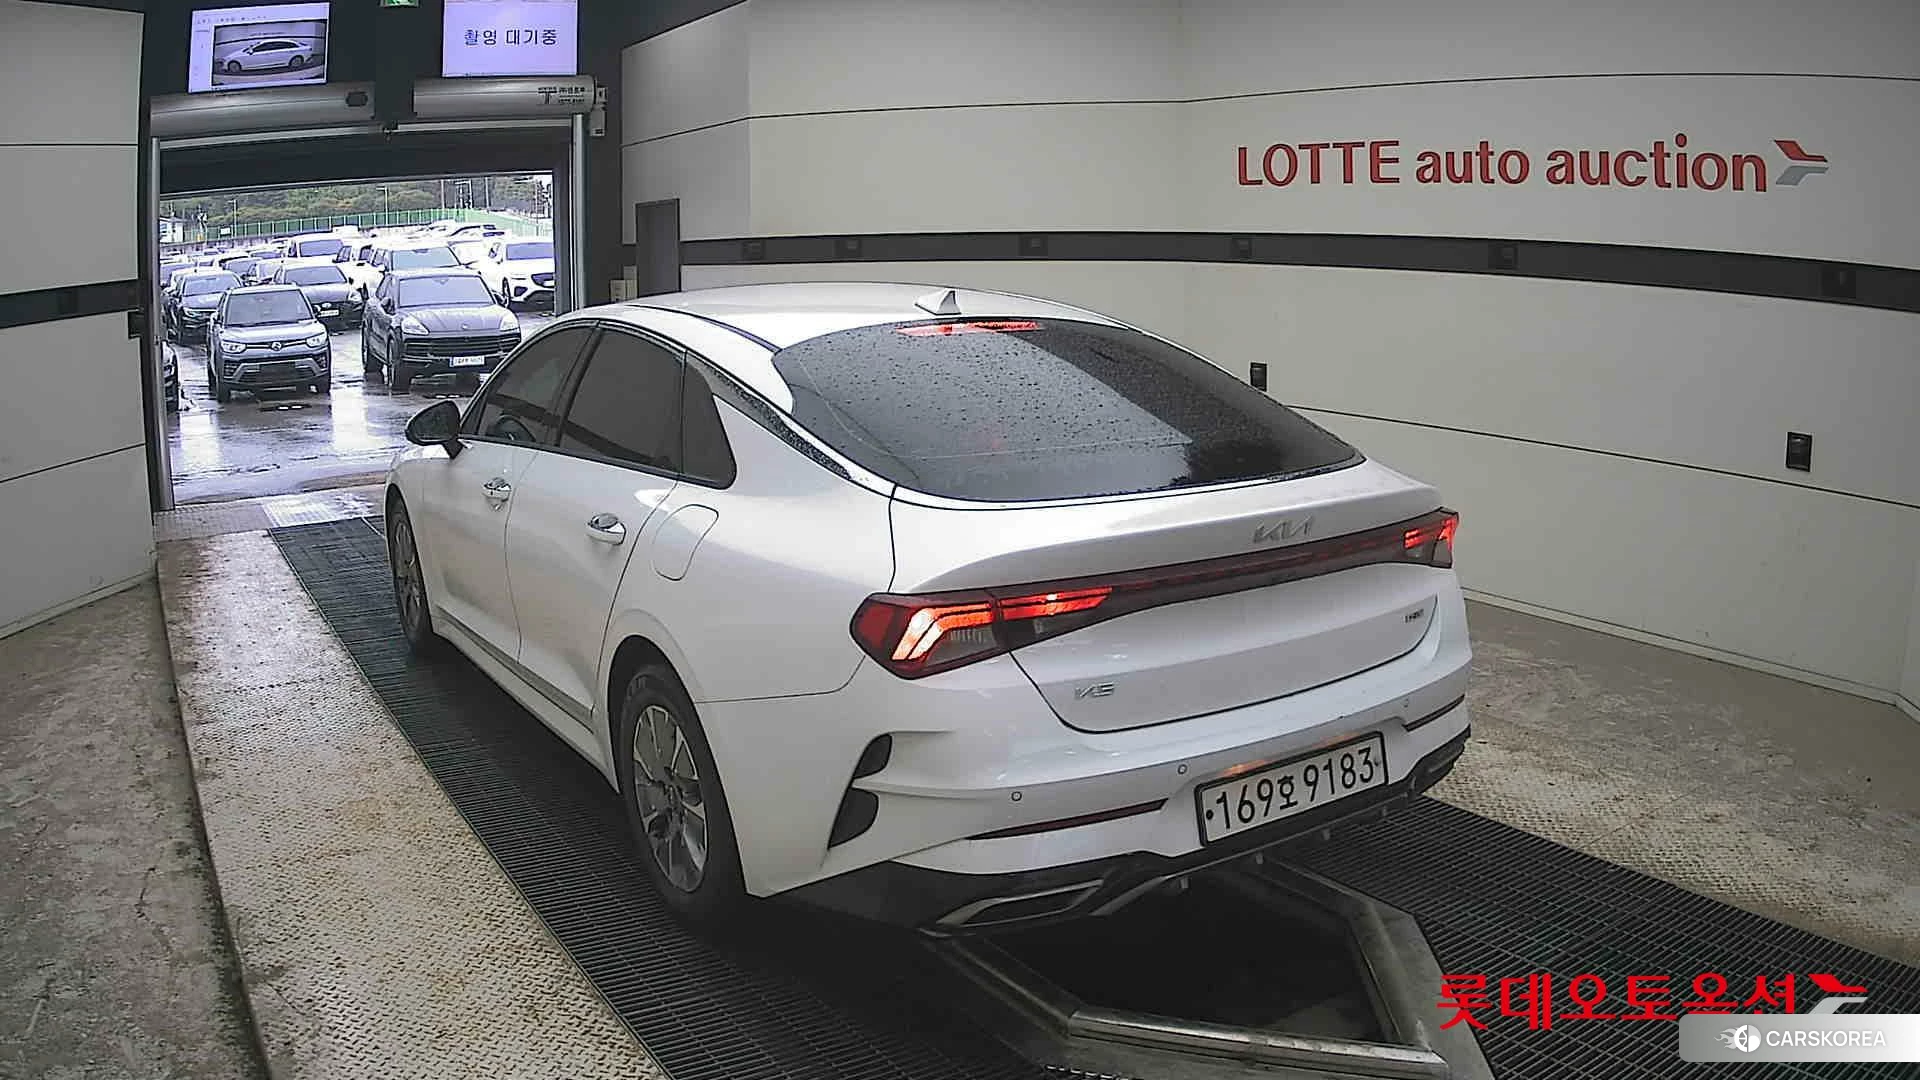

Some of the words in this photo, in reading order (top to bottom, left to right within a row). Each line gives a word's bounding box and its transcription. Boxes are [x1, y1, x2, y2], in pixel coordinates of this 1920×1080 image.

[506, 29, 557, 46] 대기중
[1238, 140, 1400, 187] LOTTE
[1415, 141, 1530, 185] auto
[1546, 133, 1767, 193] auction
